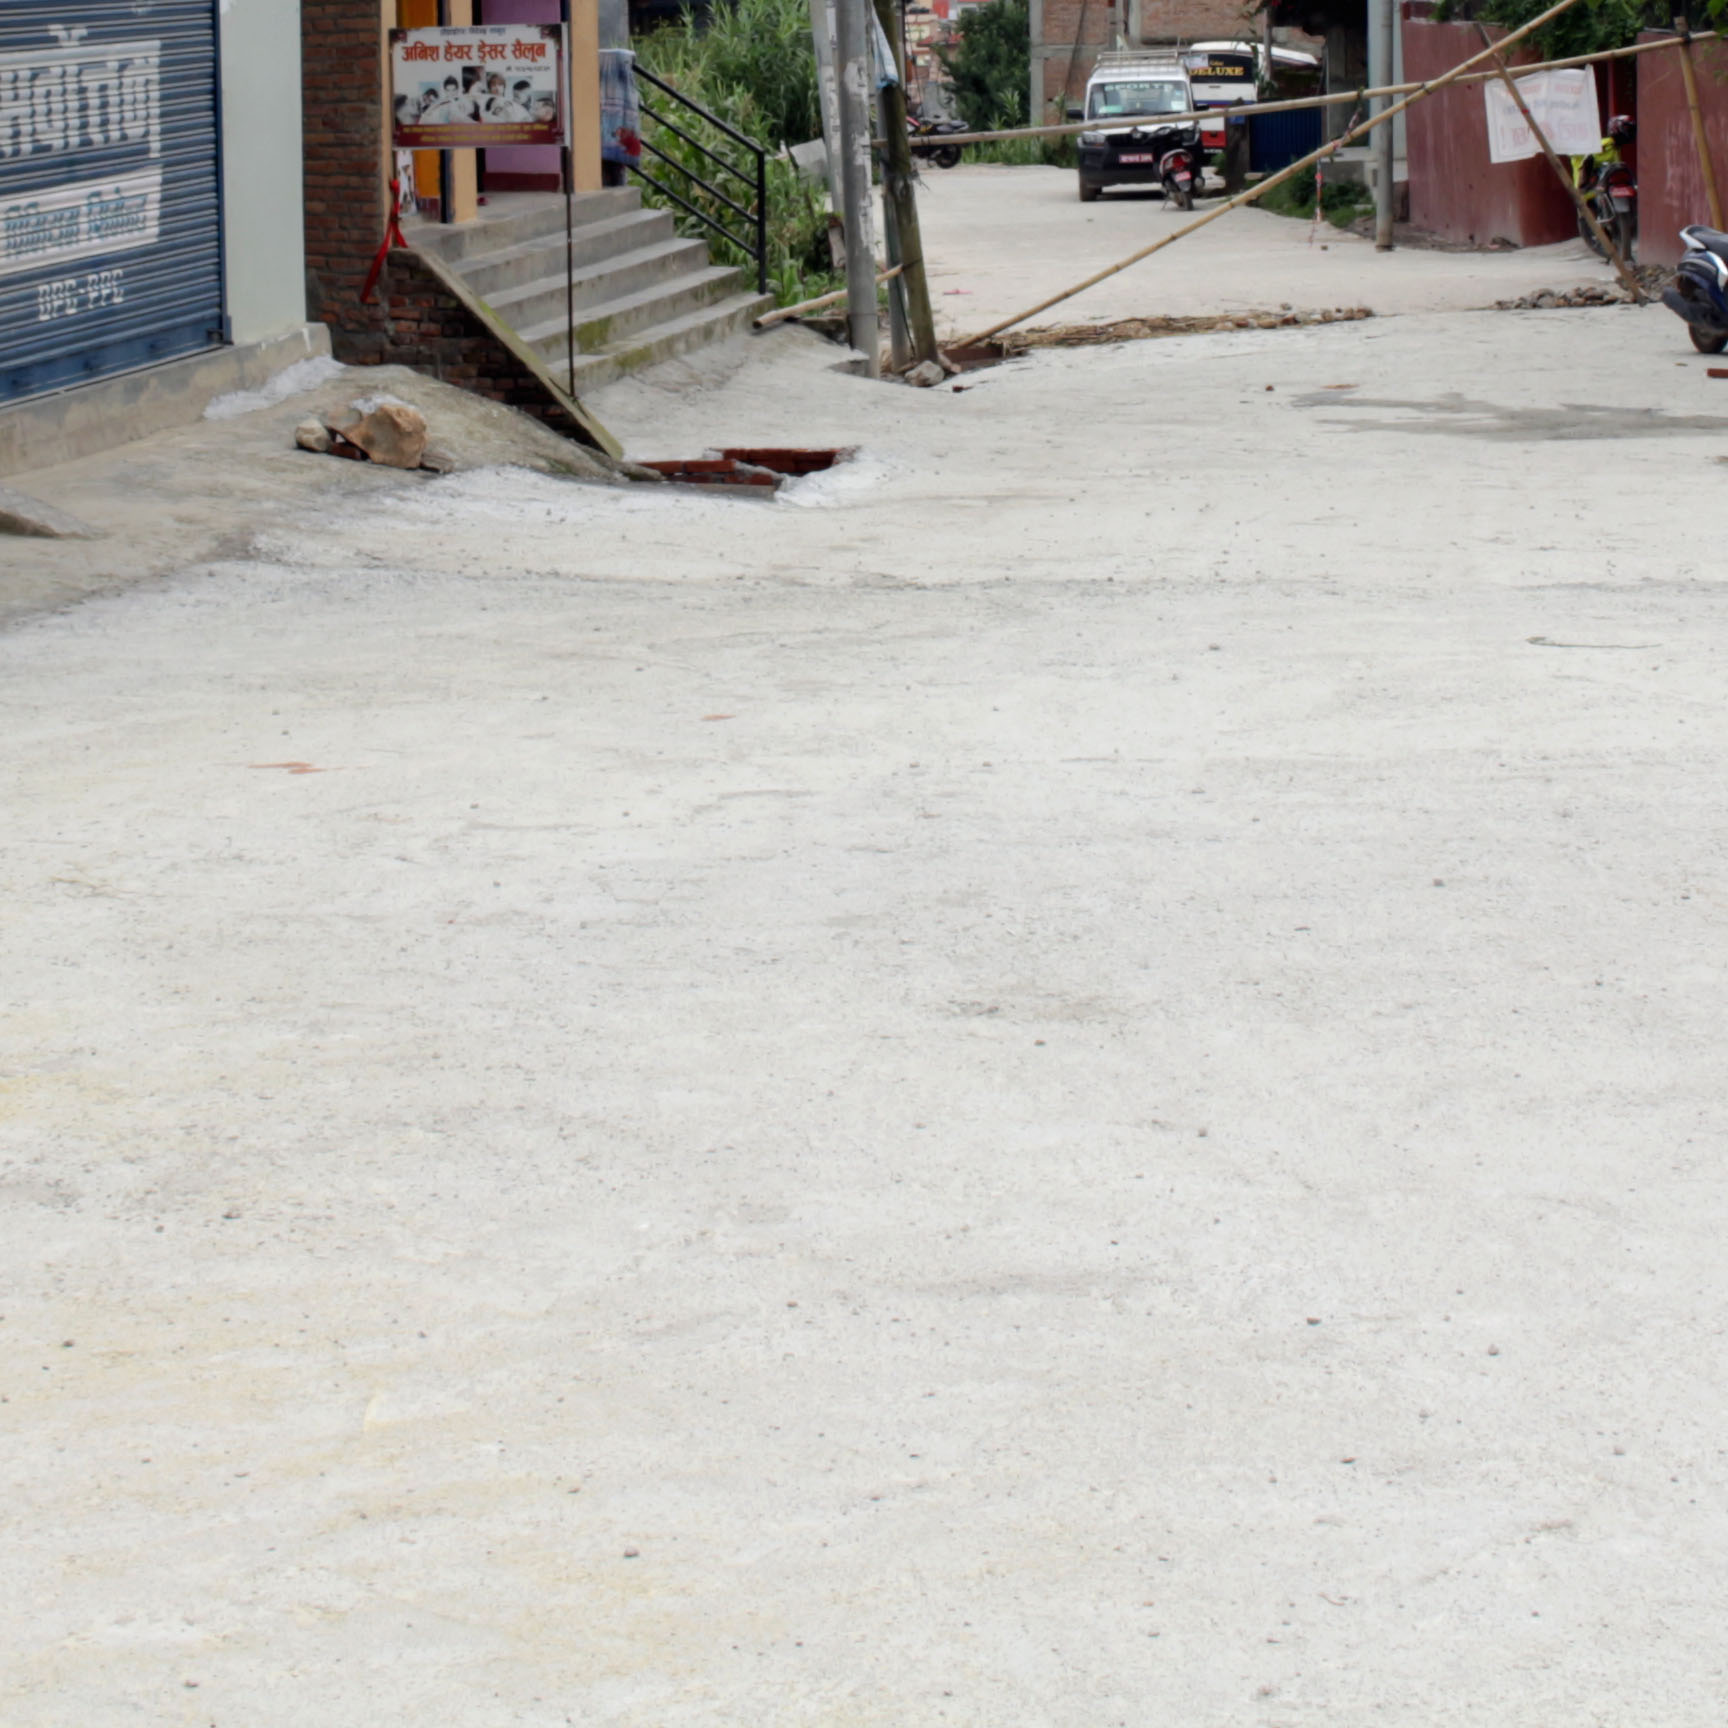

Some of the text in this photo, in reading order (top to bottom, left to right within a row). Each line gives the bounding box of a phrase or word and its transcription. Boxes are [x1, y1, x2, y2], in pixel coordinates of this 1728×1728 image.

[402, 41, 440, 62] अनिश
[444, 40, 473, 62] हेयर
[511, 38, 546, 62] सैलून
